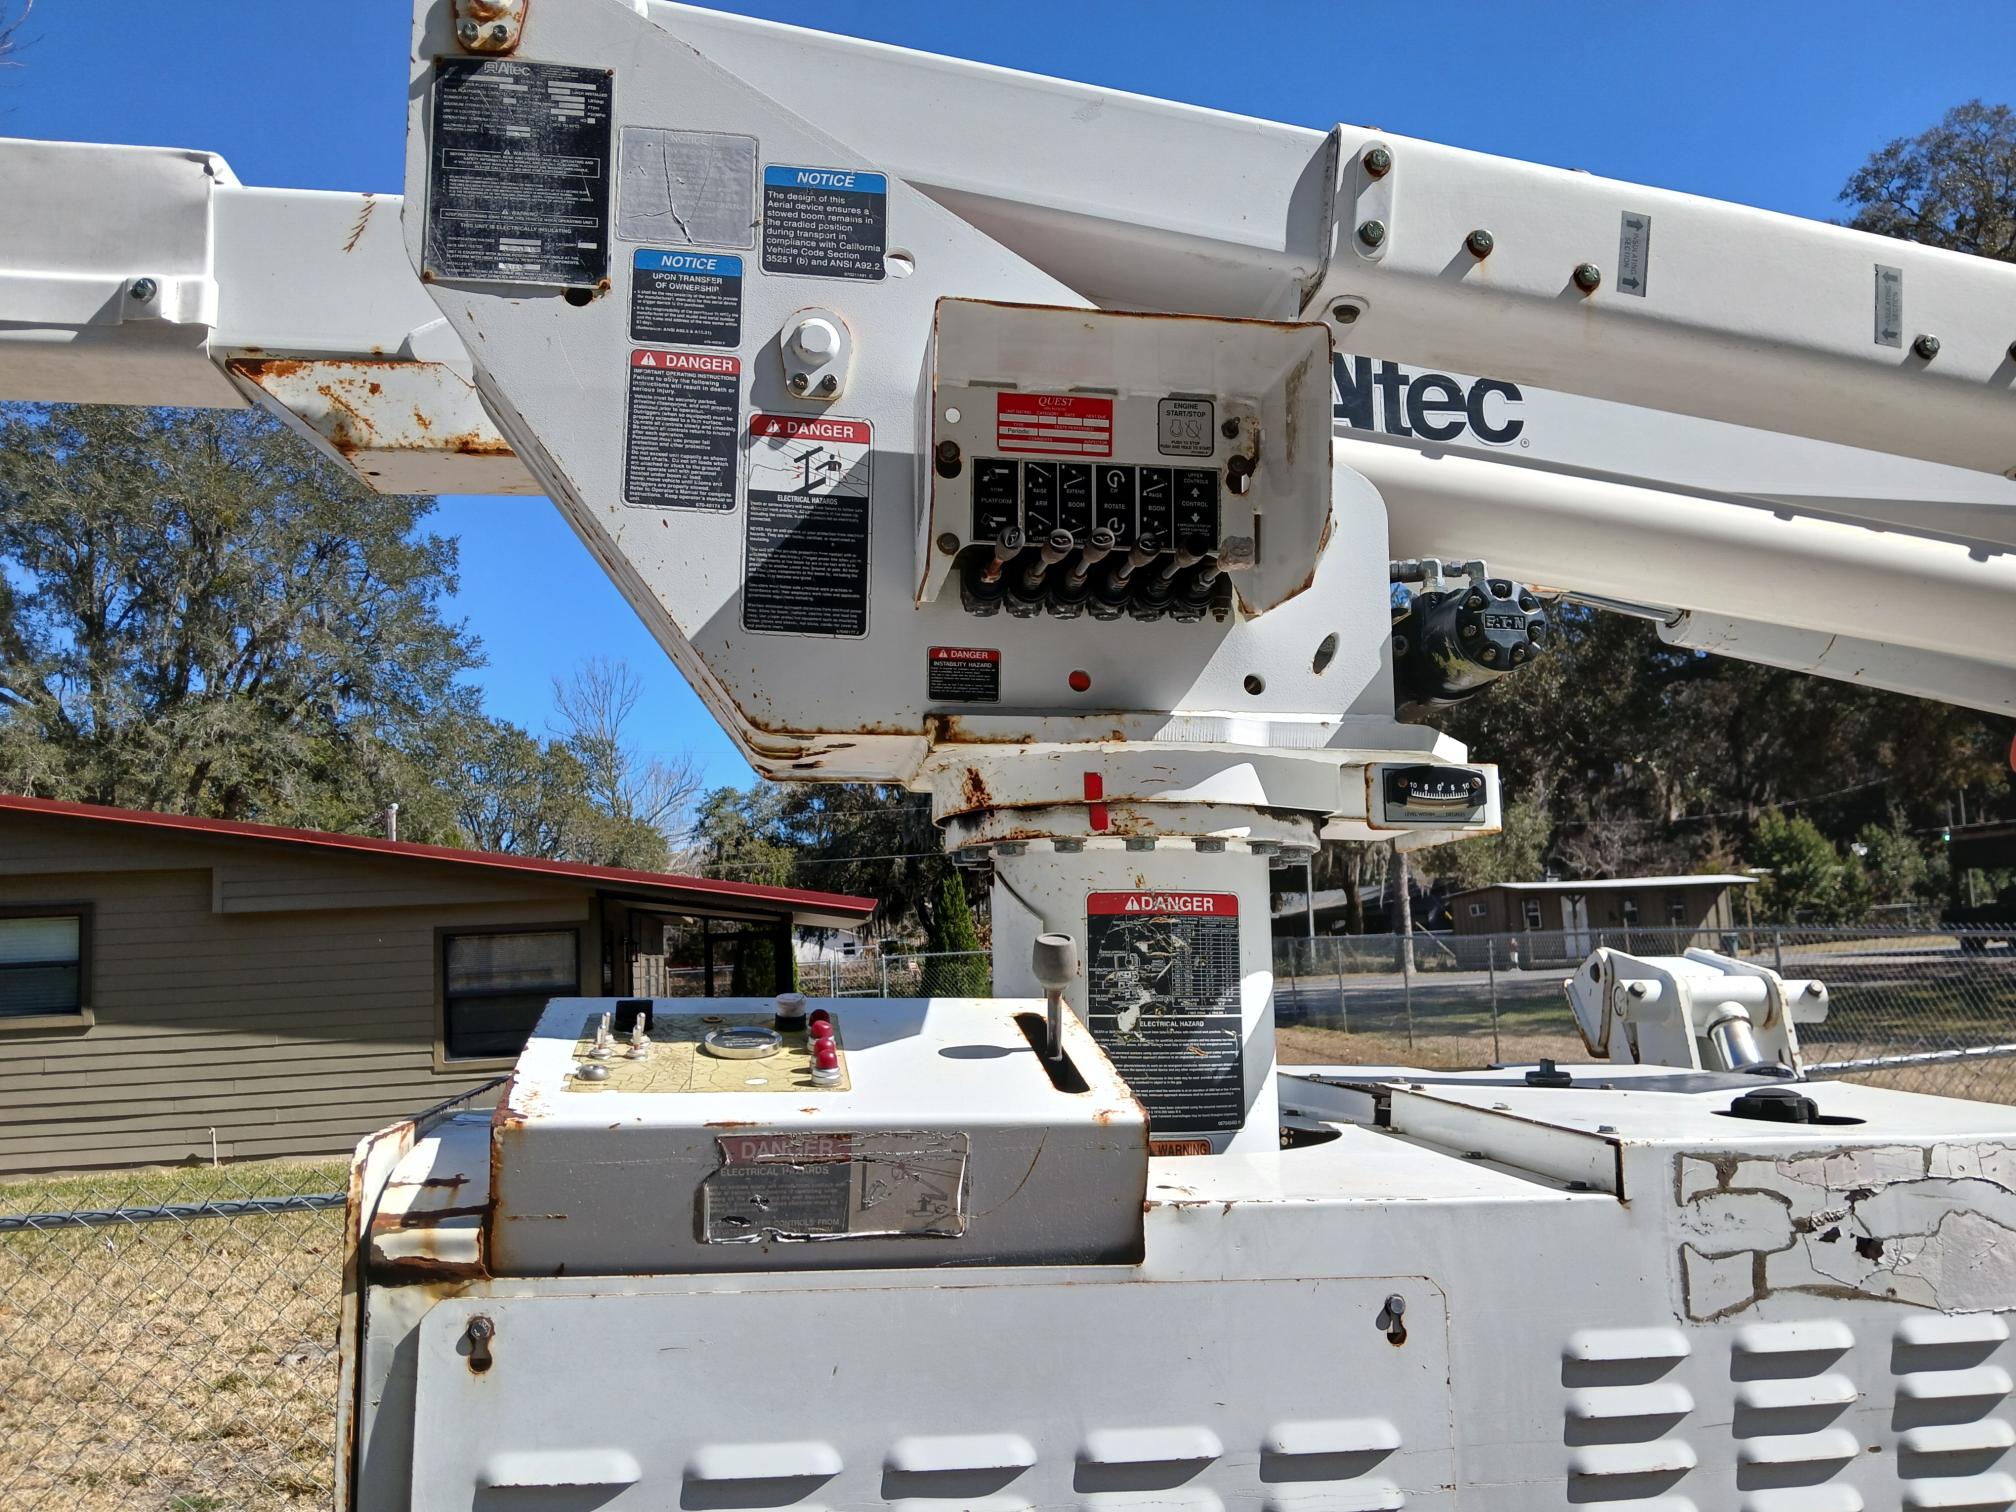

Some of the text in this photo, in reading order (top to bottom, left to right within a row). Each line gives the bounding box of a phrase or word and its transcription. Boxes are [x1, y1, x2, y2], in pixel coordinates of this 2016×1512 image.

[500, 62, 531, 76] Altec
[797, 172, 855, 187] NOTICE
[787, 193, 815, 202] design
[796, 203, 823, 211] device
[827, 206, 861, 214] ensures
[768, 210, 798, 218] stowed
[828, 215, 862, 223] remains
[784, 220, 815, 228] cradled
[819, 224, 852, 232] position
[767, 228, 794, 237] during
[797, 230, 836, 240] transport
[767, 238, 816, 247] compliance
[840, 242, 880, 252] California
[767, 247, 798, 255] Vehicle
[827, 250, 859, 259] Section
[661, 255, 717, 270] NOTICE
[766, 255, 792, 263] 35251
[855, 261, 882, 270] A92.2.
[679, 275, 722, 284] TRANSFER
[666, 354, 733, 371] DANGER
[1039, 395, 1076, 407] QUEST
[787, 421, 854, 439] DANGER
[778, 494, 810, 503] ELECTRICAL
[1485, 614, 1525, 630] EATON
[950, 651, 988, 659] DANGER
[1141, 896, 1214, 912] DANGER
[721, 1168, 779, 1176] ELECTRICAL
